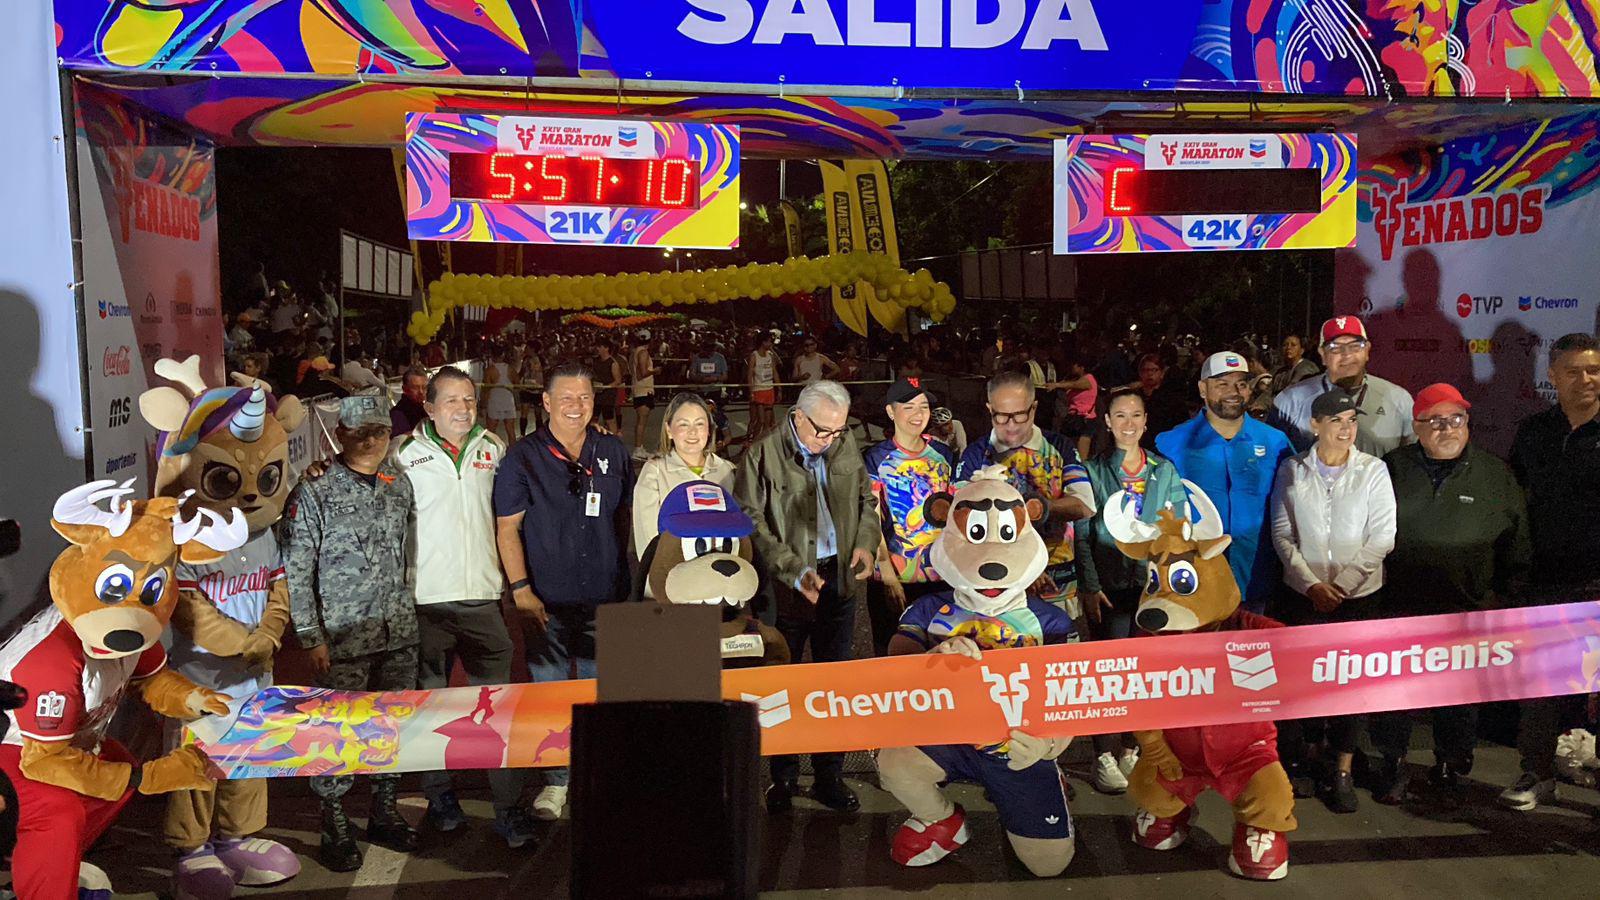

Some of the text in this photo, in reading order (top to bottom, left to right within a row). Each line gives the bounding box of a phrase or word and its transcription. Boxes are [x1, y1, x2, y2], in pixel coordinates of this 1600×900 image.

[676, 0, 1109, 51] SALIDA
[542, 125, 561, 133] XXIV
[539, 132, 612, 147] MARATÓN
[1181, 147, 1245, 159] MARATÓN
[550, 210, 604, 235] 21K
[1187, 219, 1242, 241] 42K
[108, 302, 132, 316] Chevron
[1473, 296, 1503, 314] TVP
[1535, 297, 1578, 309] Chevron
[200, 565, 270, 603] Mazatl
[1225, 641, 1271, 652] Chevron
[1045, 656, 1139, 677] XXIV GRAN
[1312, 640, 1514, 685] dportenis
[1044, 665, 1216, 706] MARATÓN
[804, 687, 955, 719] Chevron
[1044, 706, 1128, 722] MAZATLÁN 2025
